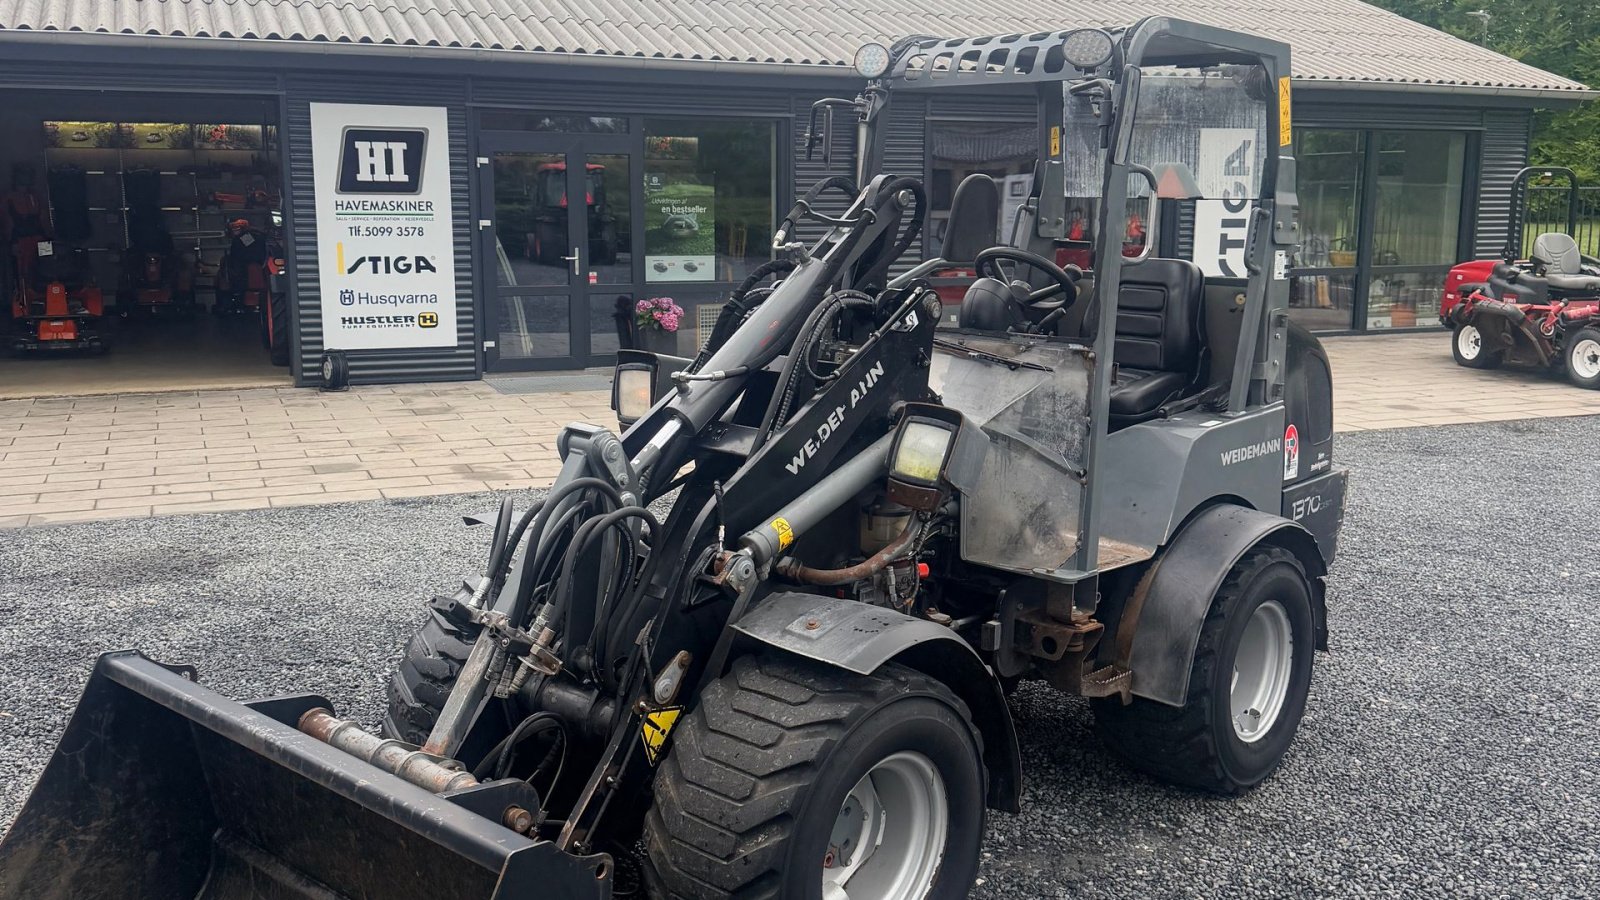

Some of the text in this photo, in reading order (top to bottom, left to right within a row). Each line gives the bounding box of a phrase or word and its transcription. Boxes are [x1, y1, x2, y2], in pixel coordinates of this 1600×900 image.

[354, 141, 409, 182] HI
[335, 200, 434, 211] HAVEMASKINER
[672, 205, 707, 214] bestseller
[348, 226, 424, 237] Tlf.5099 3578
[347, 256, 437, 274] STIGA
[358, 292, 438, 307] Husqvarna
[341, 315, 415, 325] HUSTLER
[1220, 438, 1281, 467] WEIDEMANN
